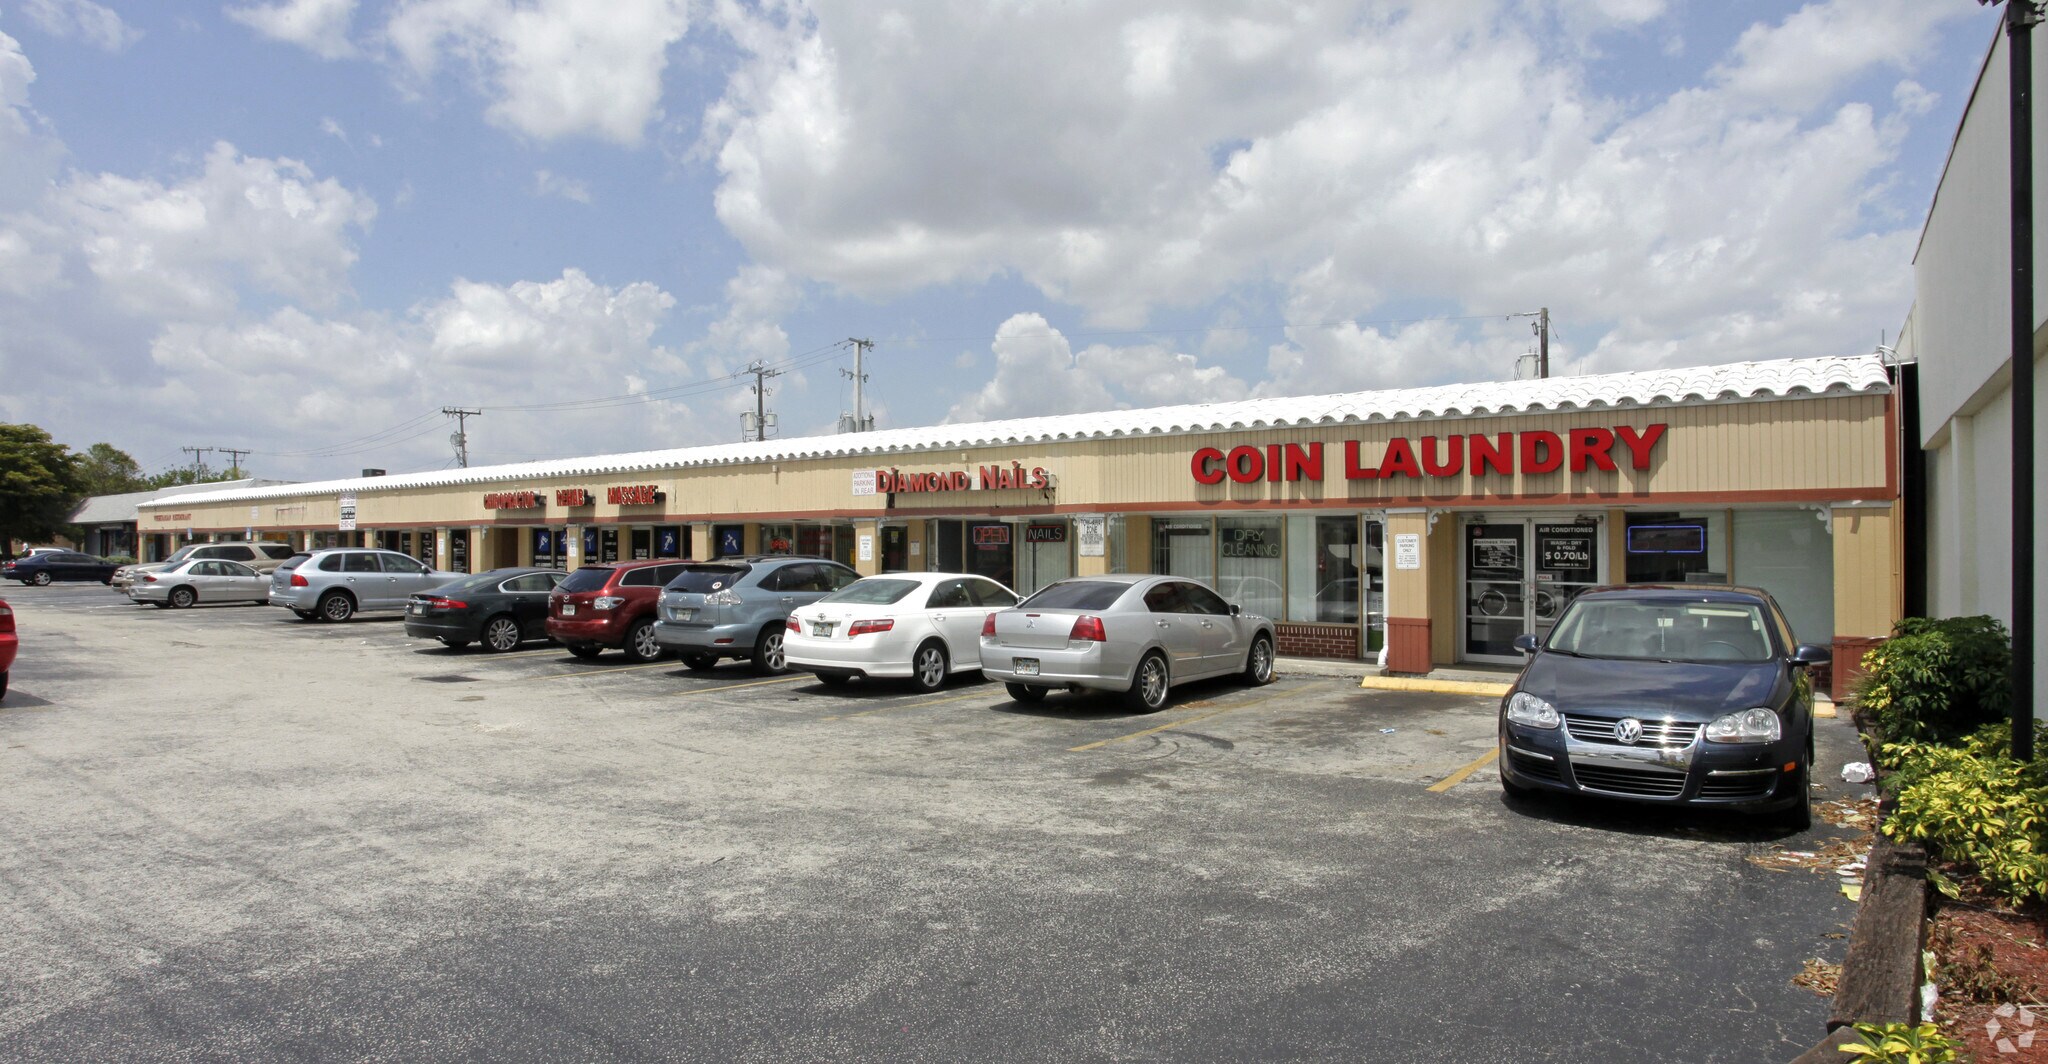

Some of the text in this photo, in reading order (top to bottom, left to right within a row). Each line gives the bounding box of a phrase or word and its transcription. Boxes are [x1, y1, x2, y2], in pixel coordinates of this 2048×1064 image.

[1191, 424, 1668, 485] COIN LAUNDRY
[853, 479, 875, 487] PARKING
[556, 488, 584, 507] REHAB
[607, 485, 655, 505] MASSAGE
[974, 526, 1008, 544] OPEN
[1028, 527, 1062, 540] NAILS
[1234, 529, 1264, 541] DRY
[1221, 543, 1279, 557] CLEANING
[1553, 551, 1588, 560] 0.70/Lb
